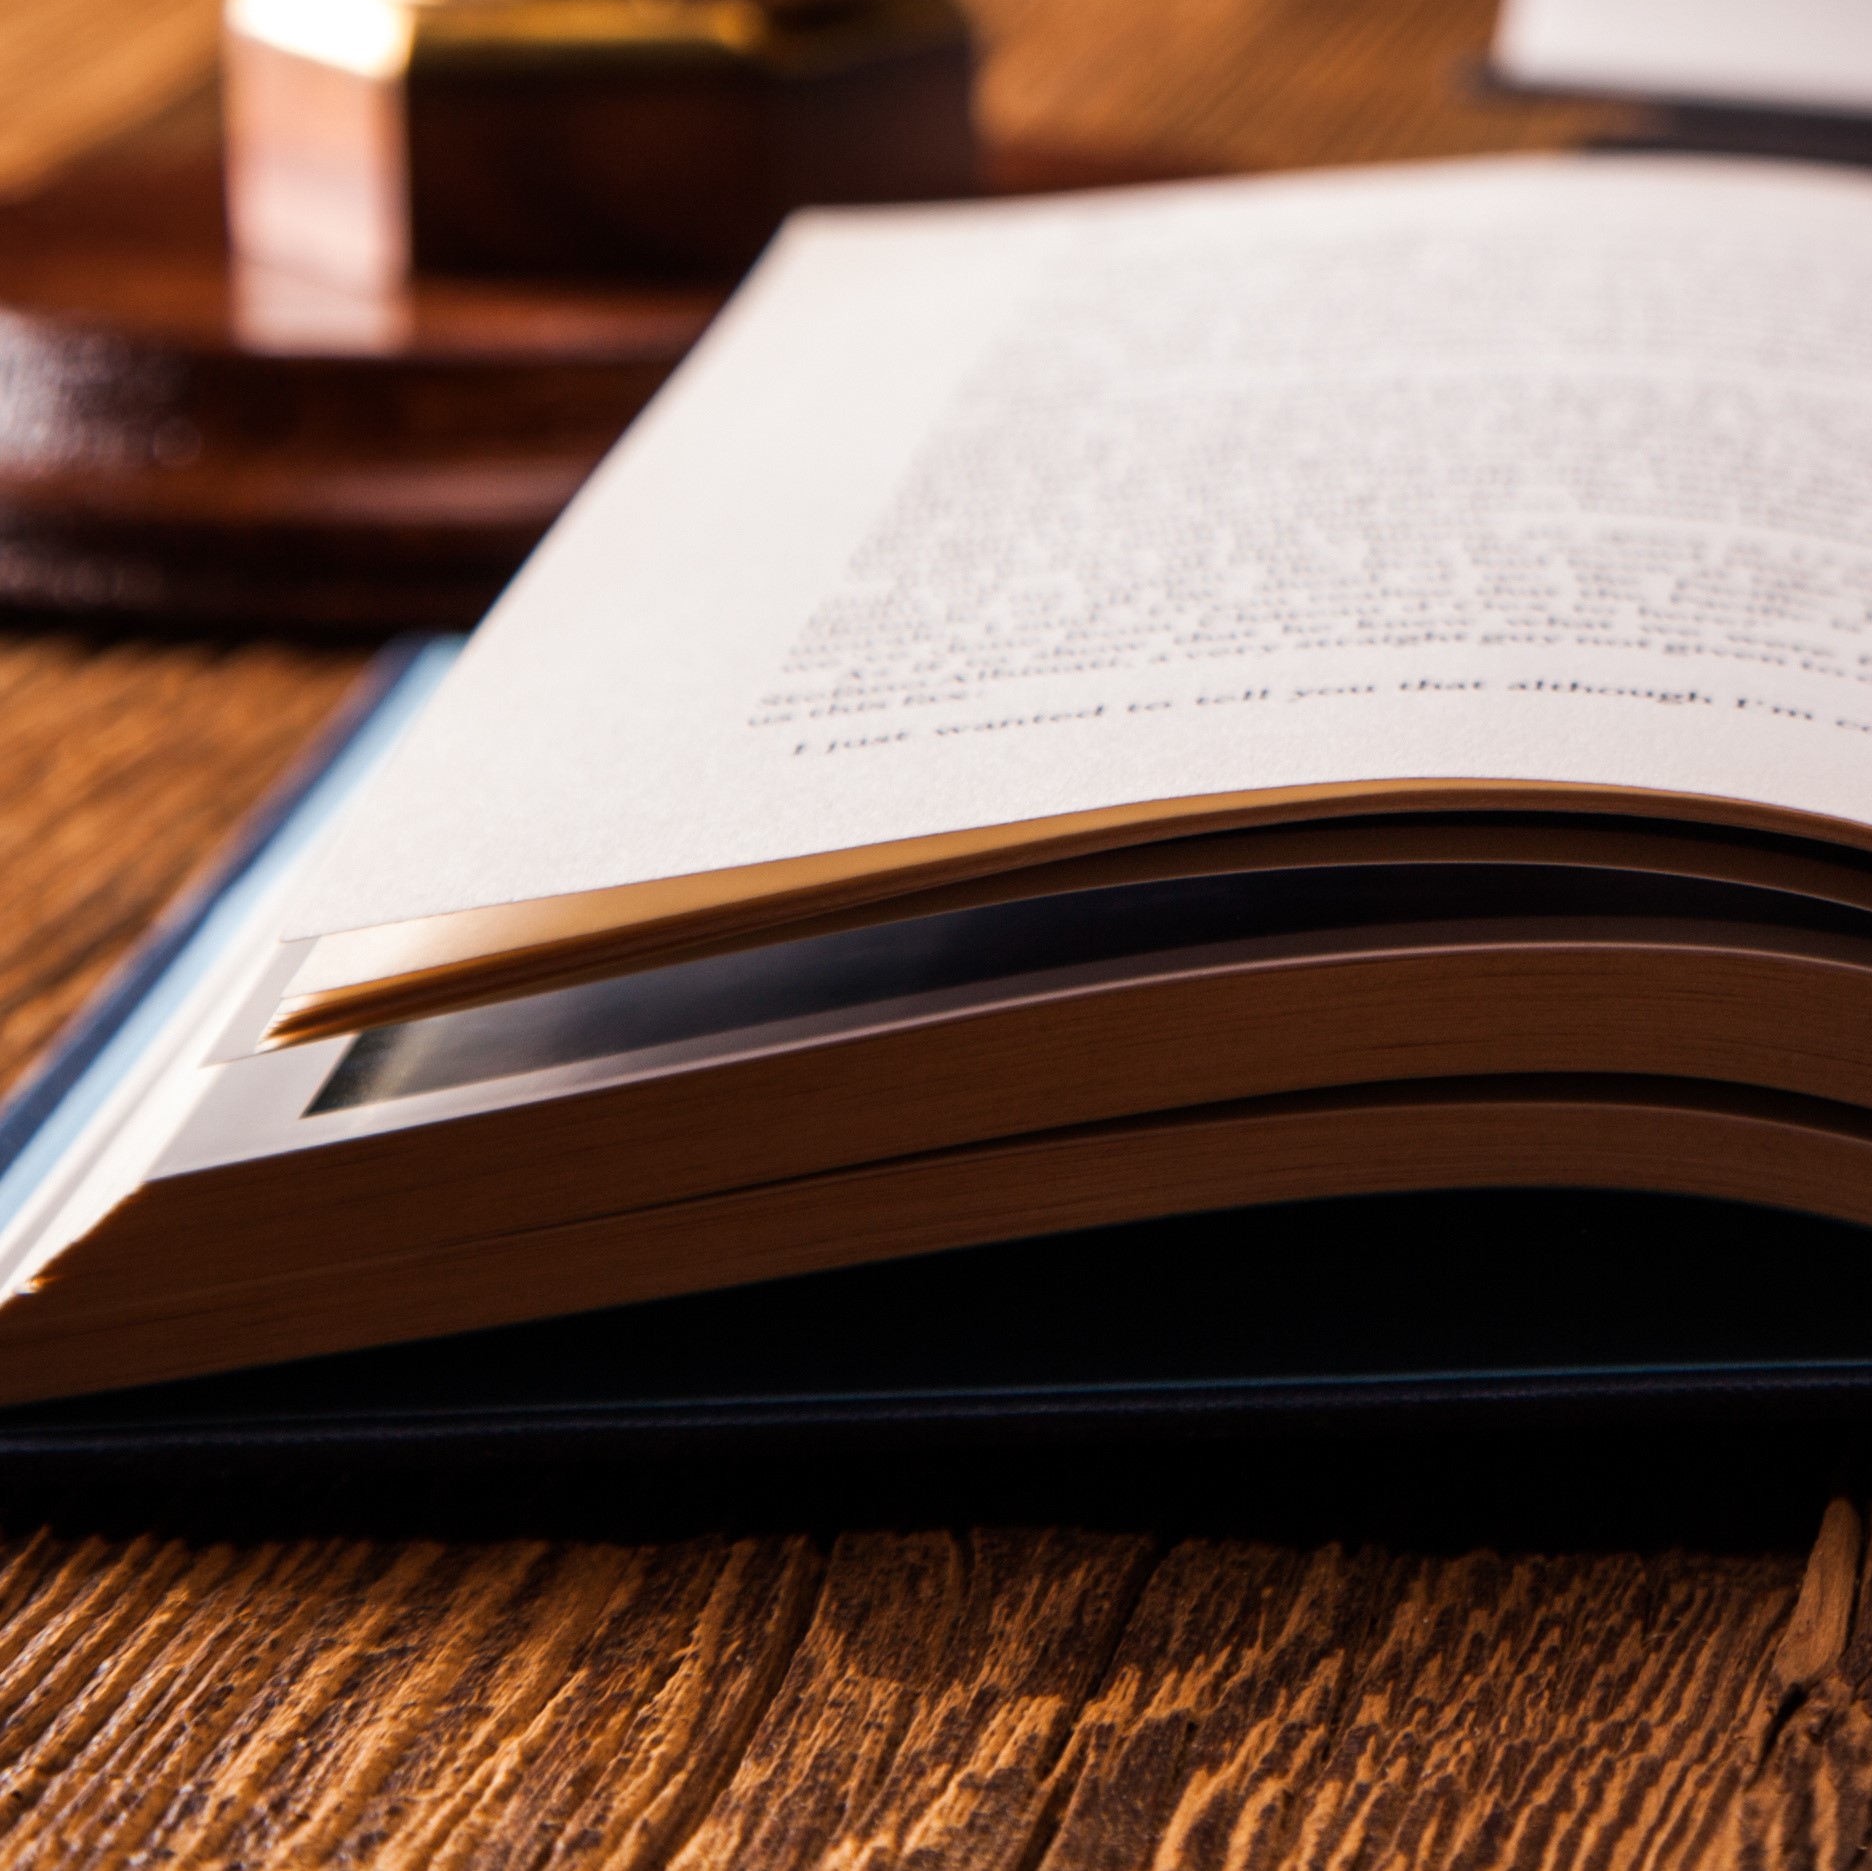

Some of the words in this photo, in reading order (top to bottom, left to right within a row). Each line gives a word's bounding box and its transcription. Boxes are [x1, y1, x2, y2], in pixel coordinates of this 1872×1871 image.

[1295, 630, 1468, 650] straight
[792, 741, 808, 757] I
[825, 730, 910, 755] just
[934, 703, 1107, 737] wanted
[1126, 699, 1173, 714] to
[1194, 686, 1272, 707] tell
[1288, 683, 1376, 703] you
[1398, 677, 1486, 692] that
[1506, 677, 1714, 706] although
[1734, 696, 1815, 722] I'm
